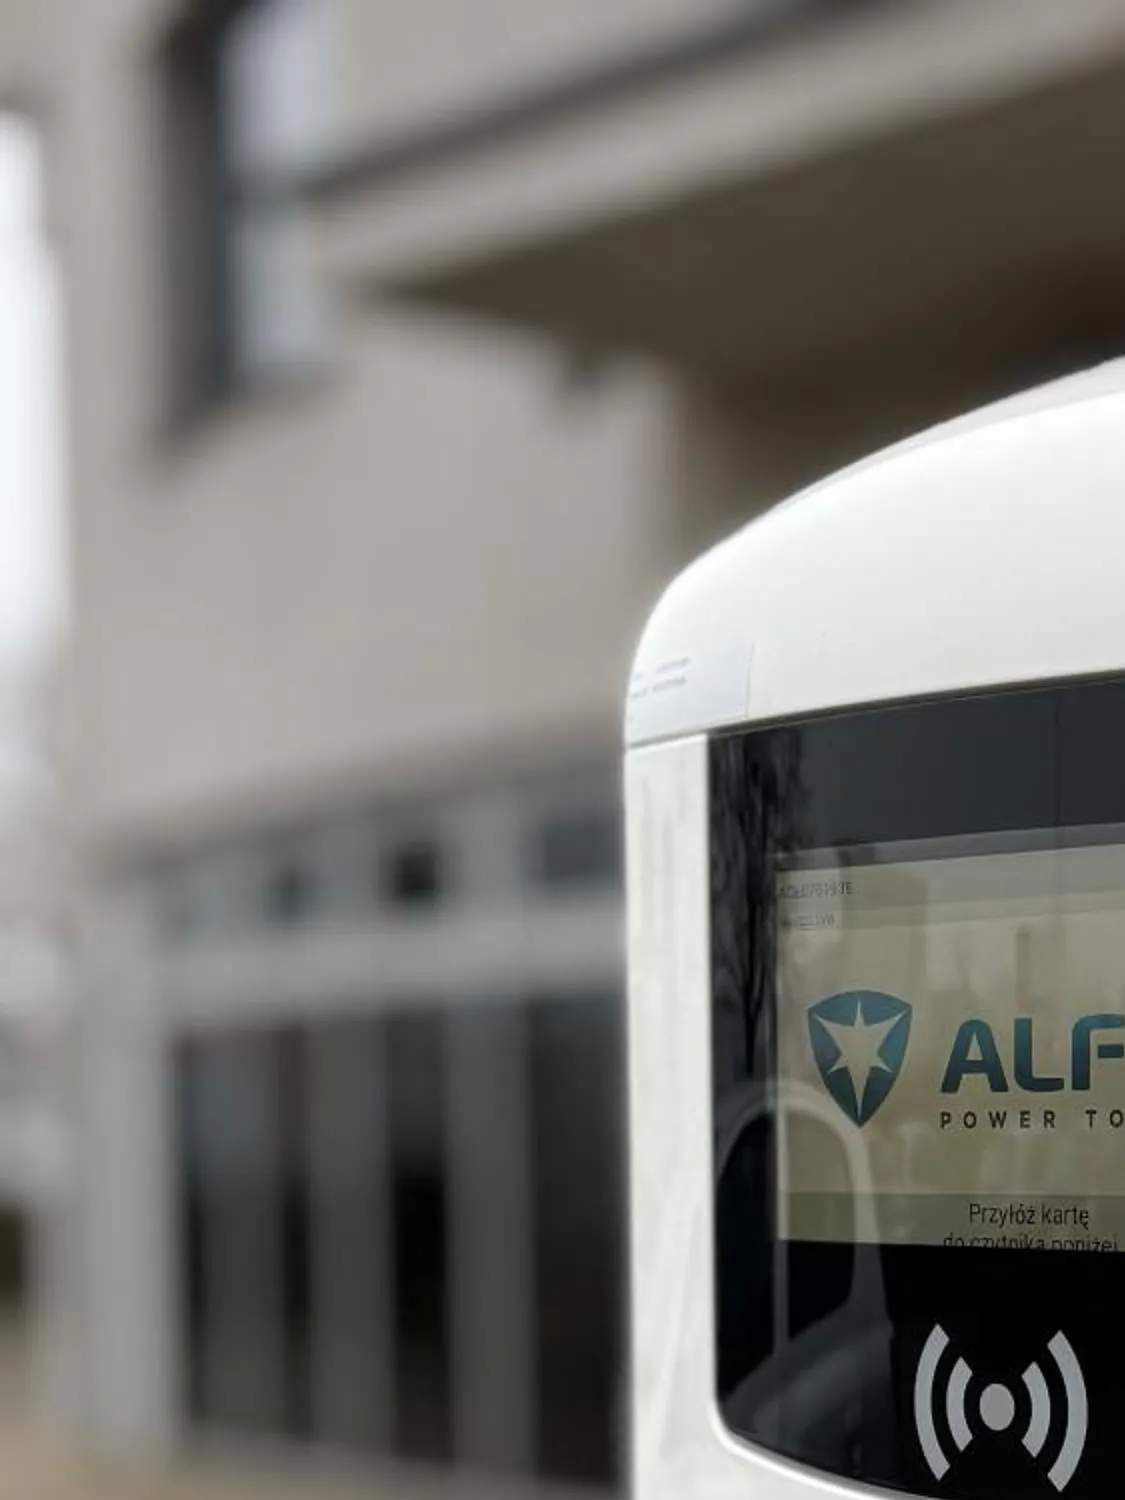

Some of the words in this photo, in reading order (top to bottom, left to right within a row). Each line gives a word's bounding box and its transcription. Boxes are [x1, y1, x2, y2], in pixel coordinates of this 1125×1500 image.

[939, 1109, 1056, 1130] POWER
[1085, 1109, 1125, 1128] TO
[968, 1203, 1036, 1229] Przyłóż
[1041, 1203, 1090, 1231] kartę
